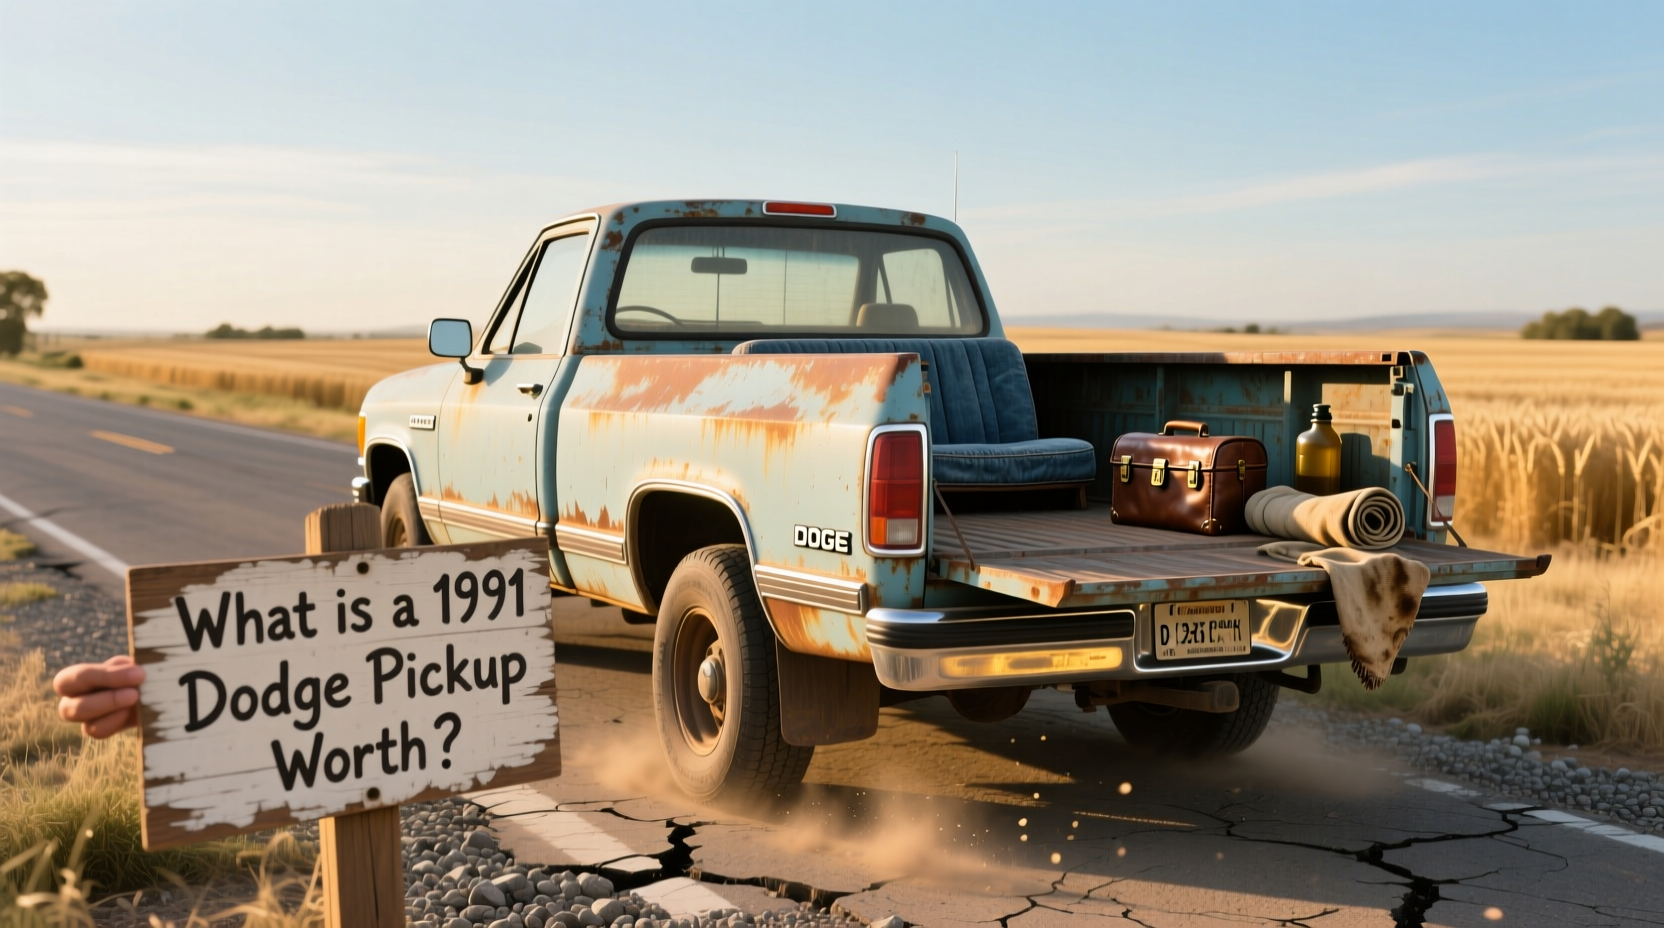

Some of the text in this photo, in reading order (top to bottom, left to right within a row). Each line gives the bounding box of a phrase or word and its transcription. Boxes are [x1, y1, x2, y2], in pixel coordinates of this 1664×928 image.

[794, 525, 848, 552] DOGE
[175, 567, 525, 652] What is a 1991
[178, 643, 527, 733] Dodge Pickup
[270, 711, 462, 791] Worth?
